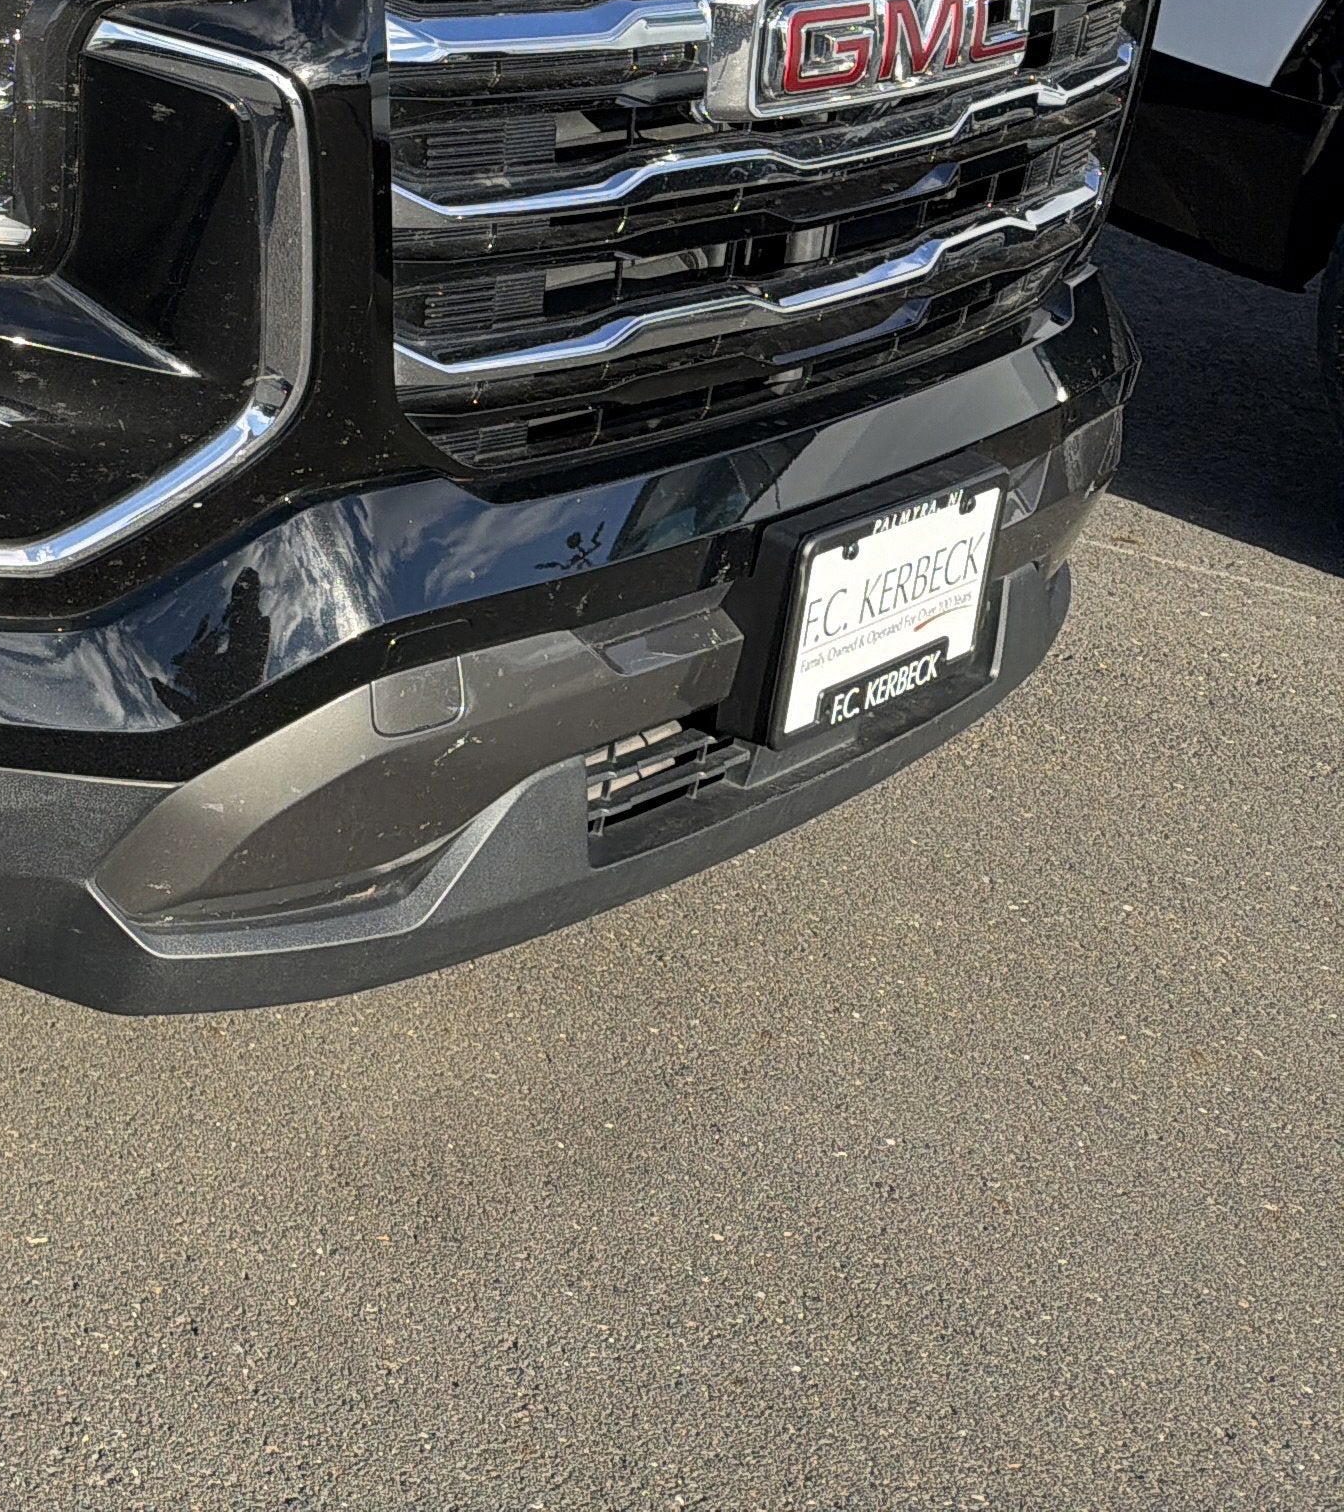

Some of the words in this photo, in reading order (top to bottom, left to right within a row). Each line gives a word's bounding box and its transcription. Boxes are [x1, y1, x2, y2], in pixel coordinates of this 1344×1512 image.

[803, 588, 847, 648] F.C.
[858, 531, 985, 625] KERBECK
[830, 689, 860, 725] F.C.
[864, 649, 942, 707] KERBECK
